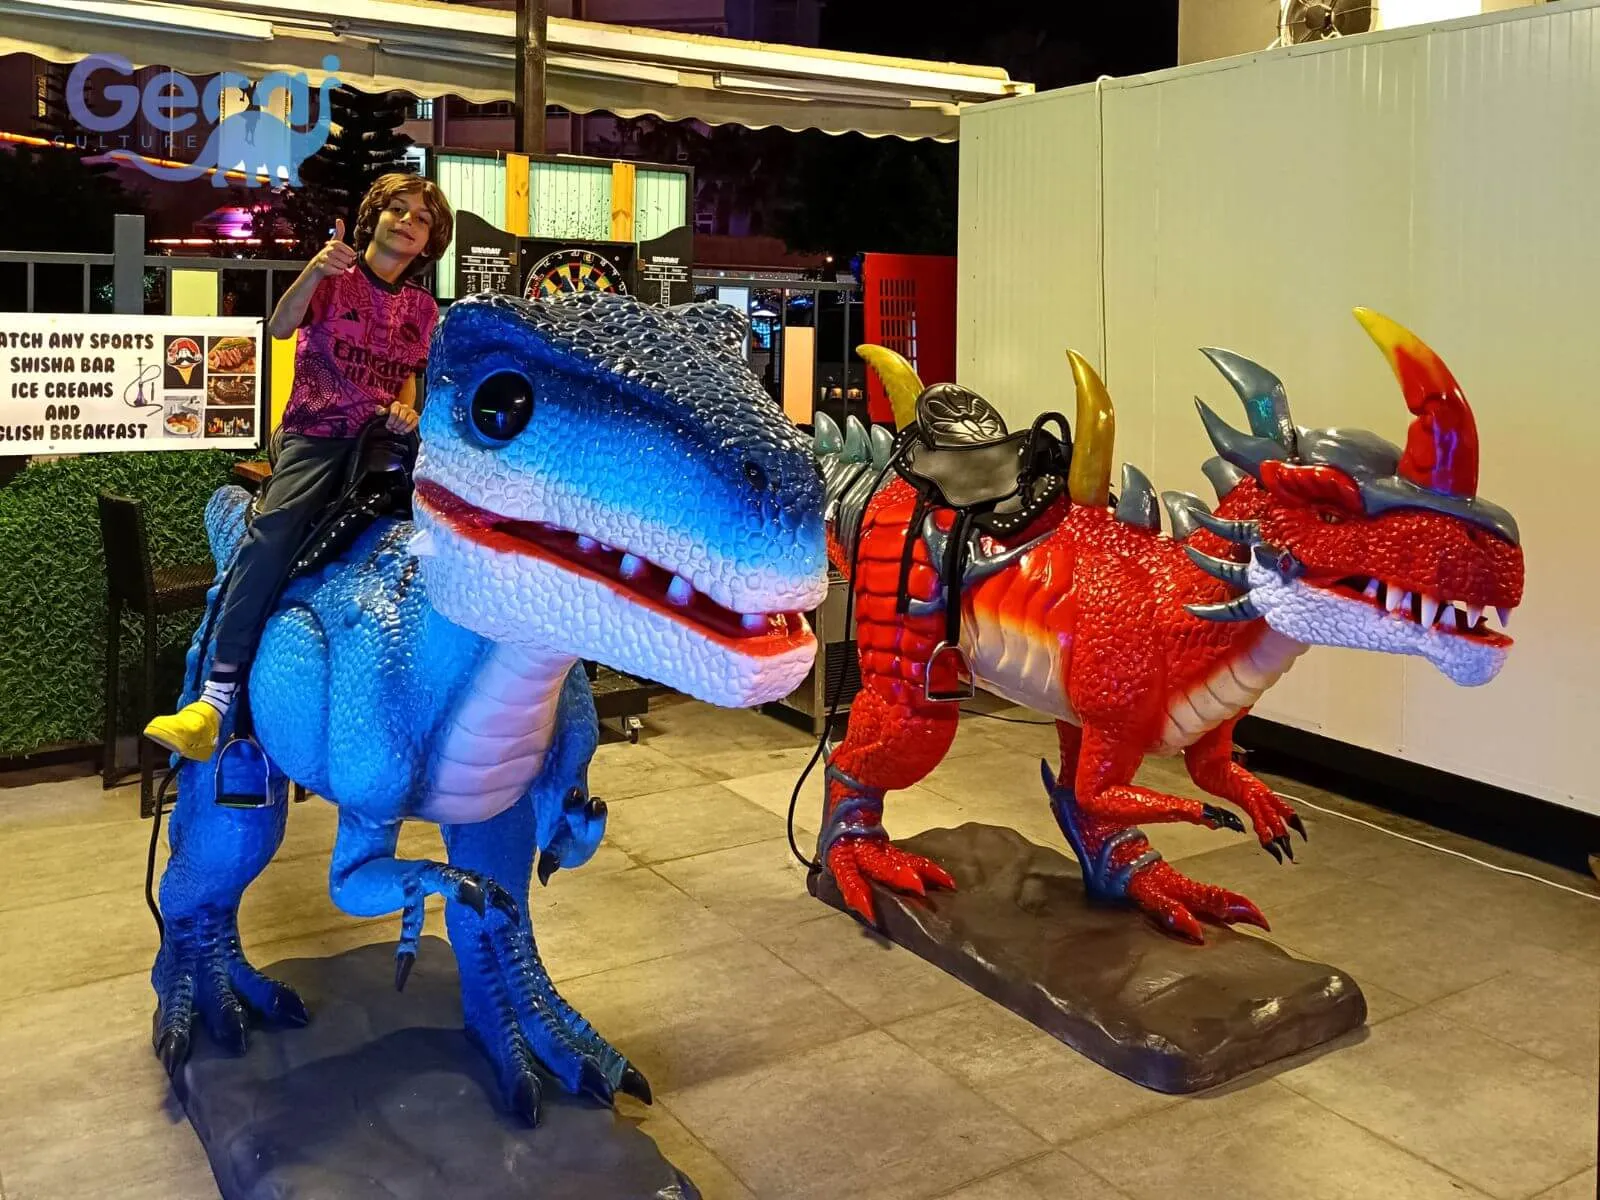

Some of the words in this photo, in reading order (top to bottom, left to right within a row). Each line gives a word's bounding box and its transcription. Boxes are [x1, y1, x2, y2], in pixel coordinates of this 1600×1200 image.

[0, 332, 43, 349] ATCH
[49, 332, 84, 349] ANY
[90, 334, 154, 350] SPORTS
[10, 357, 75, 373] SHISHA
[81, 357, 115, 373] BAR
[11, 382, 38, 399] ICE
[45, 382, 114, 398] CREAMS
[45, 404, 80, 421] AND
[50, 423, 148, 440] BREAKFAST
